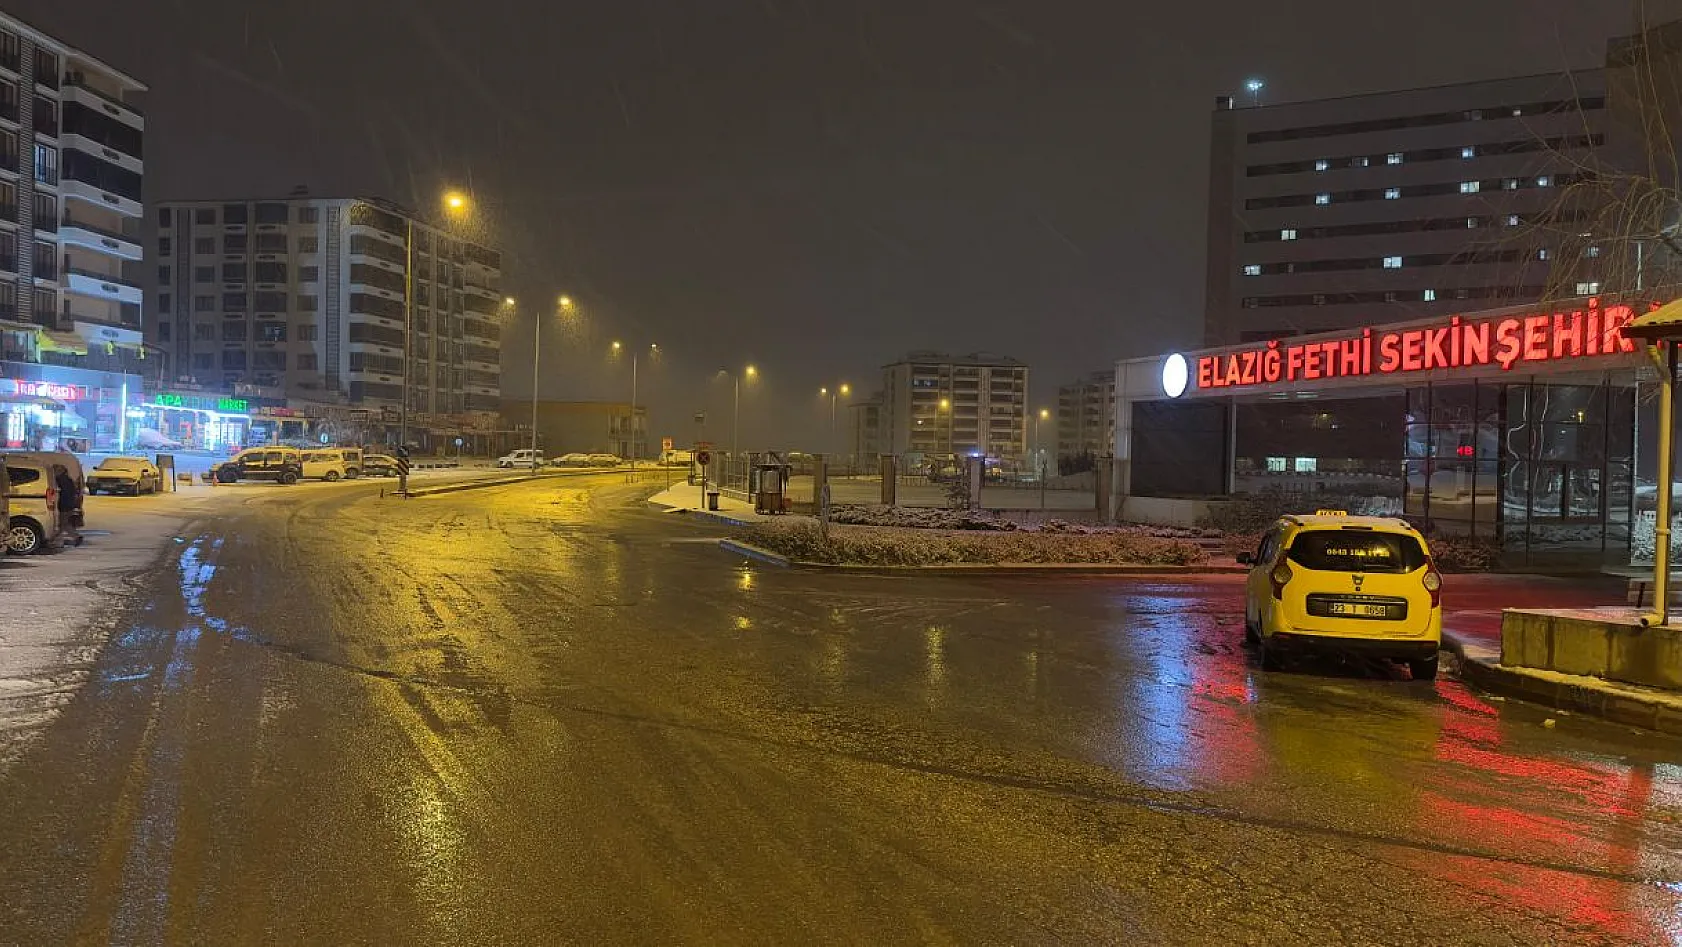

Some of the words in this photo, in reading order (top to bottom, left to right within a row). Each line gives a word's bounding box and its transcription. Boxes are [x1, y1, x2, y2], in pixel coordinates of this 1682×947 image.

[1197, 341, 1283, 389] ELAZIĞ
[1286, 327, 1371, 381] FETHİ
[1379, 316, 1492, 372] SEKİN
[1494, 297, 1634, 371] ŞEHİR
[218, 398, 249, 411] MARKET
